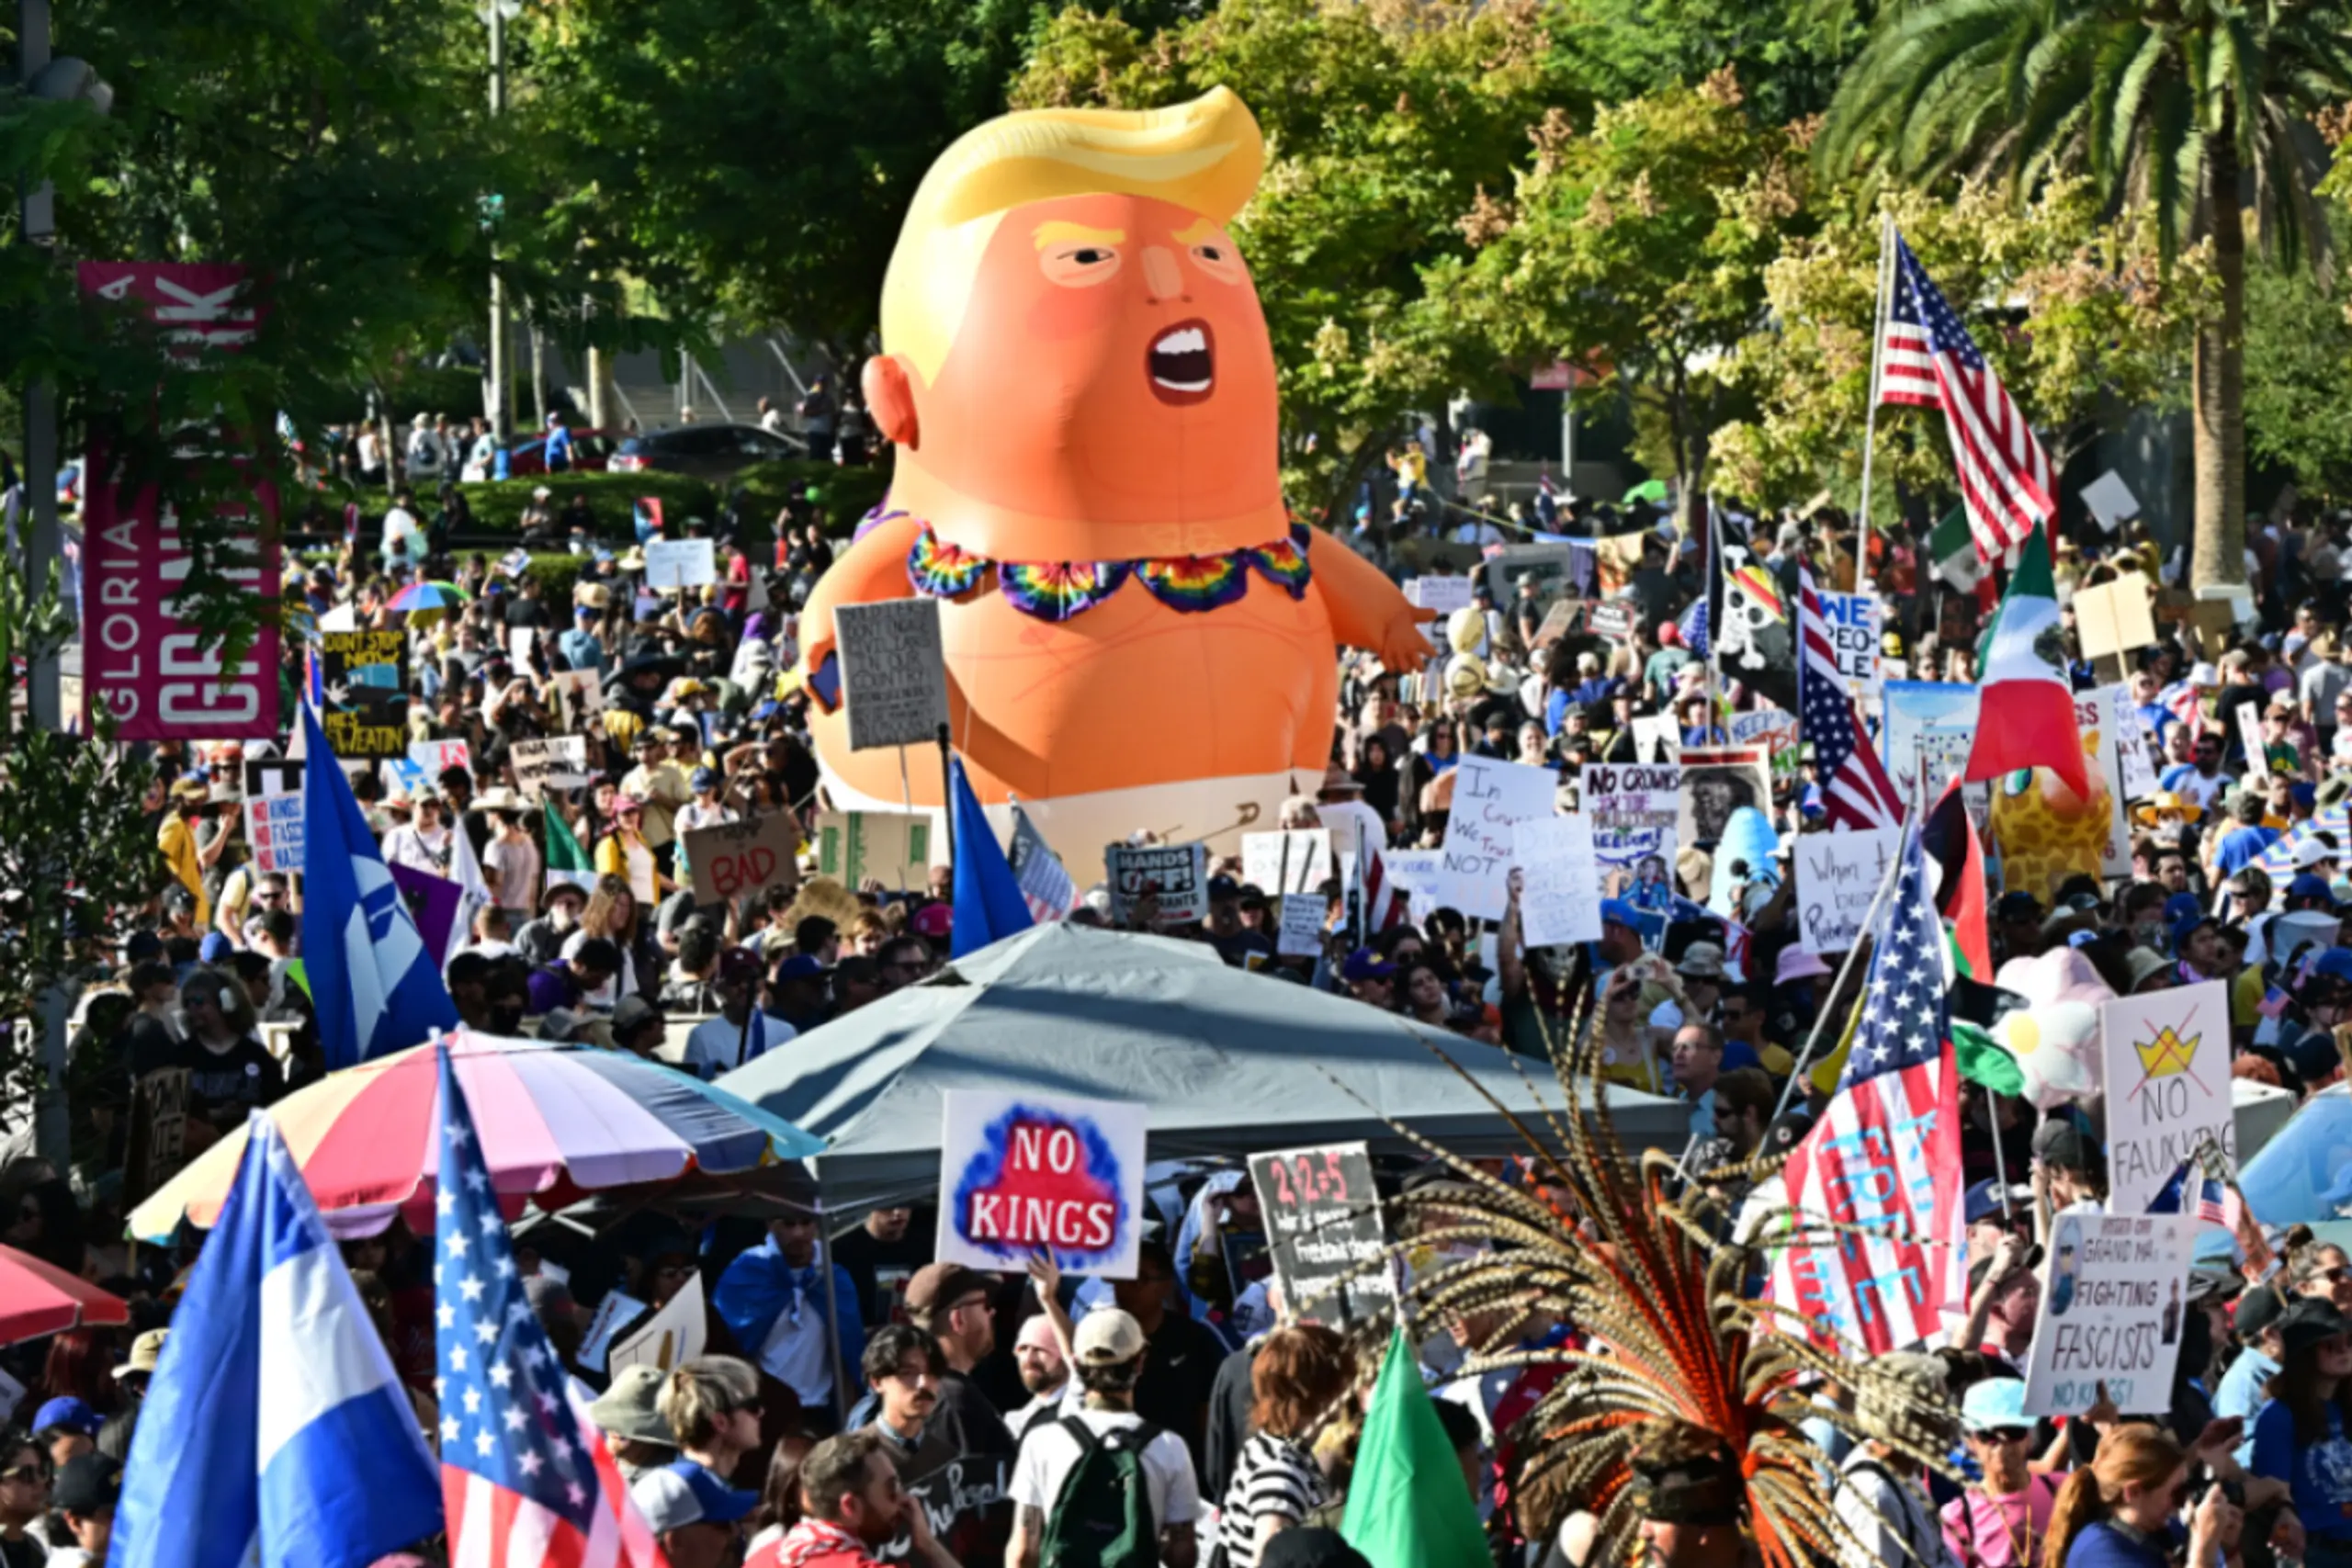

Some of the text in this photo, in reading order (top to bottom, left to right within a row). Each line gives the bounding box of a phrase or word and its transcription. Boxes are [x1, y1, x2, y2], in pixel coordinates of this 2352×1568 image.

[100, 519, 140, 722] GLORIA
[1463, 763, 1502, 801] In
[1622, 766, 1680, 793] CROWNS
[1453, 815, 1479, 842] We
[1480, 836, 1514, 857] Trus
[710, 847, 776, 896] BAD
[1119, 850, 1191, 868] HANDS
[1443, 852, 1501, 875] NOT
[2142, 1077, 2188, 1127] NO
[1012, 1126, 1076, 1174] NO
[2114, 1133, 2181, 1188] FAUX
[969, 1191, 1114, 1247] KINGS
[2075, 1280, 2158, 1306] FIGHTING
[2051, 1322, 2158, 1371] FASCISTS
[2052, 1379, 2135, 1408] NO KIGS!
[946, 1459, 1010, 1521] Peopl
